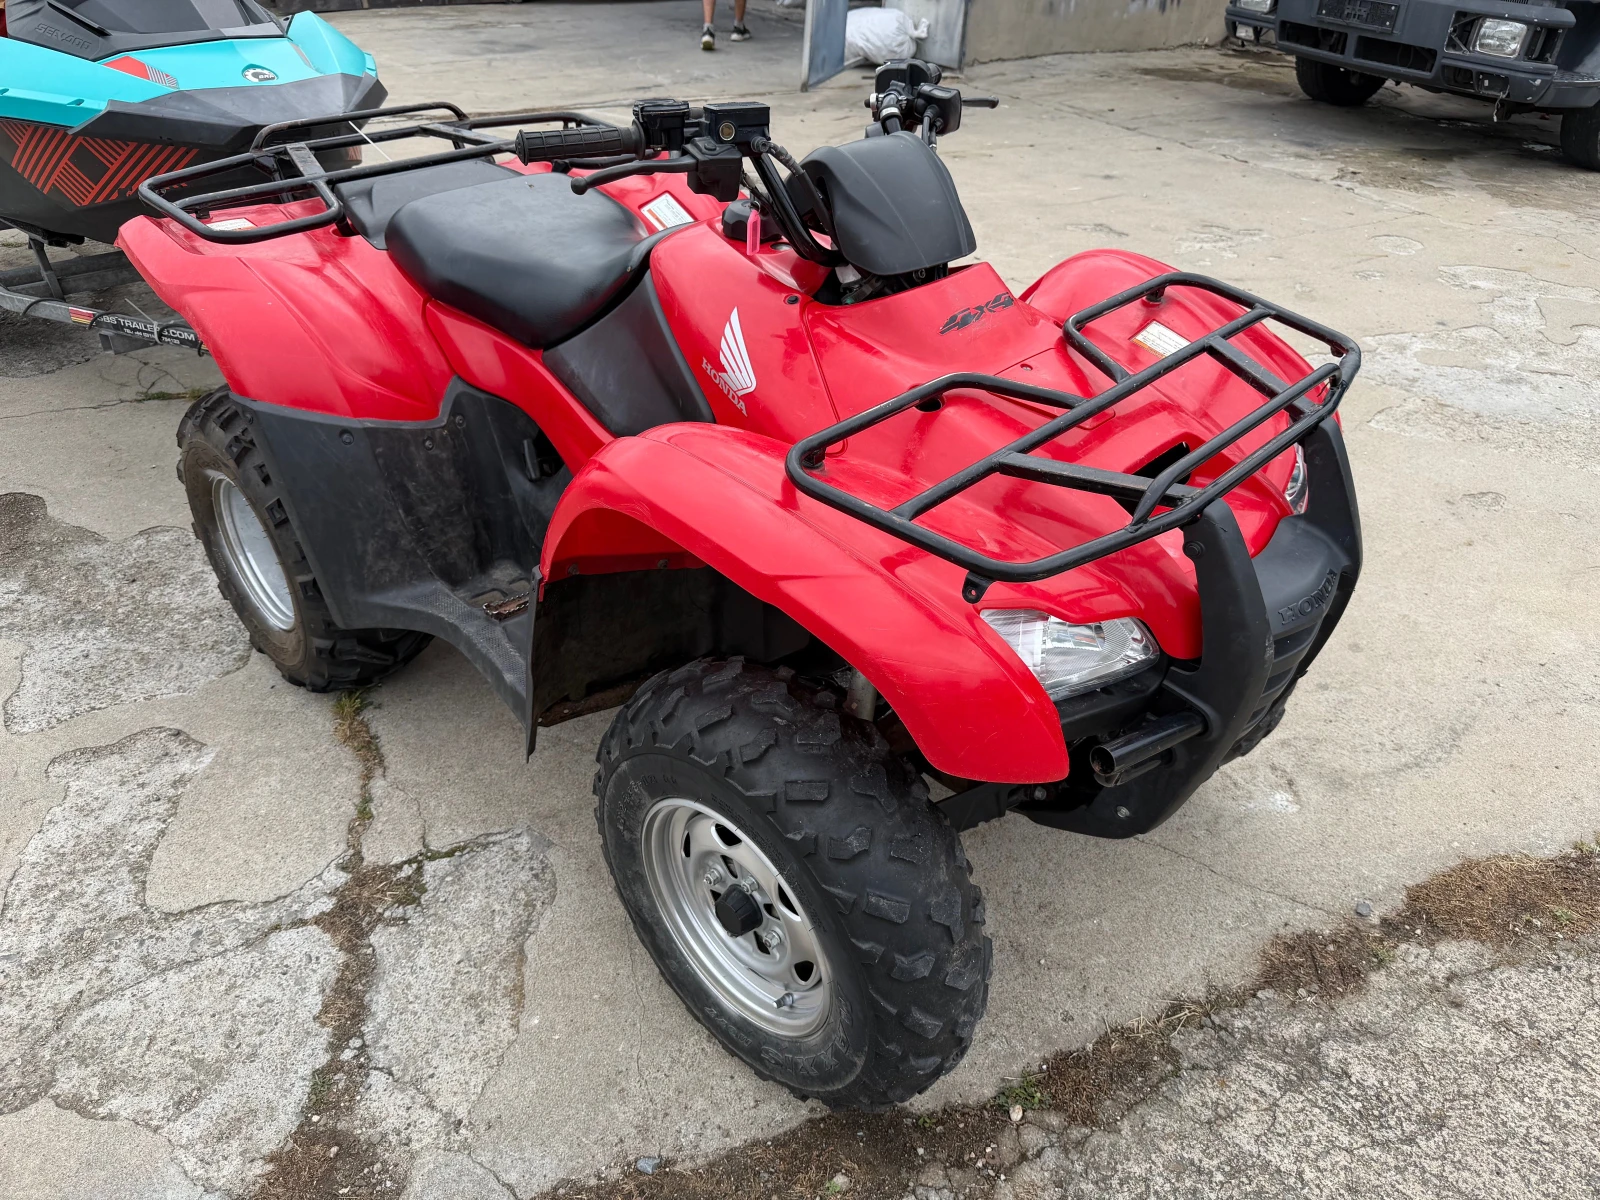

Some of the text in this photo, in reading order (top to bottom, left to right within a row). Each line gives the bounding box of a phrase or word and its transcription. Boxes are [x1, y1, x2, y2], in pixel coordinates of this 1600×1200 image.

[702, 356, 748, 417] HONDA
[1278, 568, 1338, 625] HONDA
[760, 981, 853, 1076] MAXXIS
